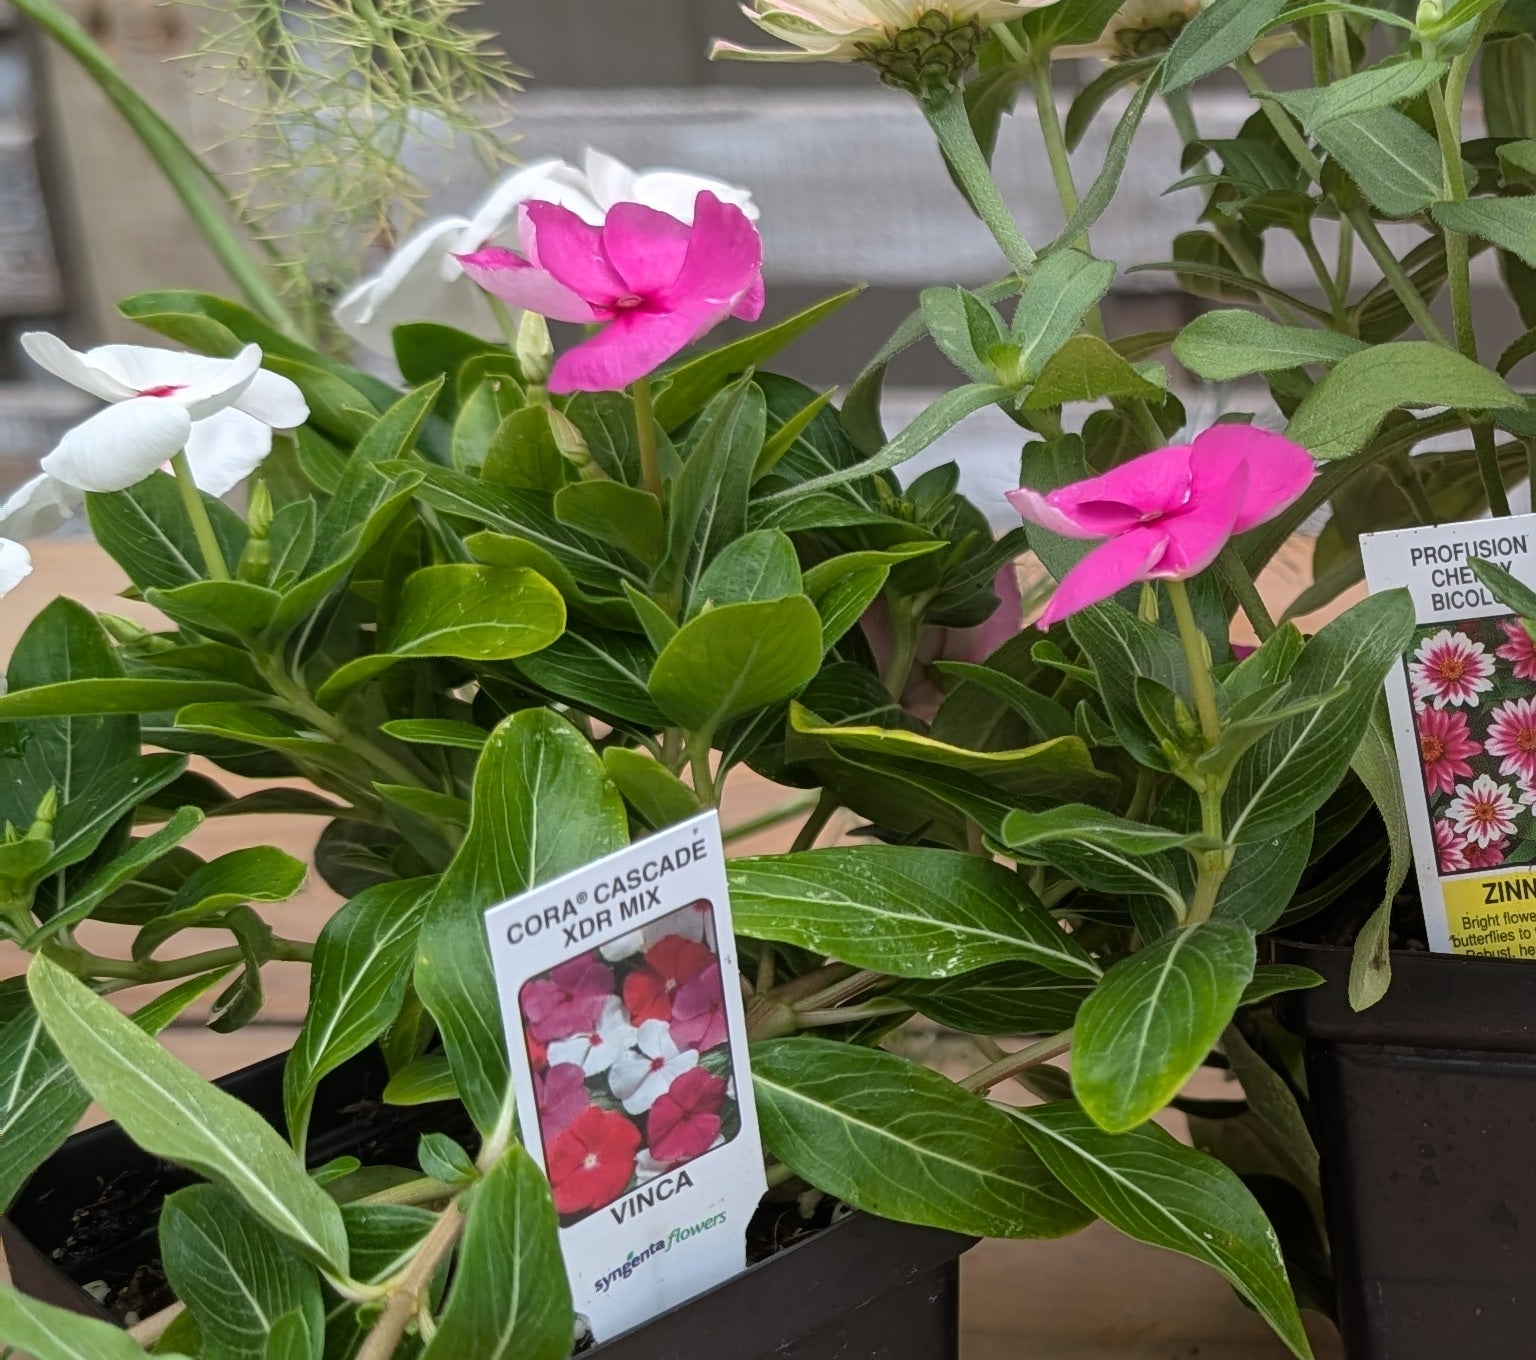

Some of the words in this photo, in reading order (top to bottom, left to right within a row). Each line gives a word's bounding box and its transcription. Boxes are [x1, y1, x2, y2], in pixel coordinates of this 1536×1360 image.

[1410, 534, 1528, 566] PROFUSION
[1431, 560, 1512, 588] CHEY
[1431, 588, 1504, 612] BICOL
[594, 838, 708, 905] CASCADE
[562, 909, 613, 948] XDR
[620, 886, 662, 921] MIX
[1461, 913, 1501, 931] Bright
[1452, 929, 1516, 948] butterflies
[1518, 927, 1532, 940] to
[610, 1170, 694, 1225] VINCA
[594, 1239, 666, 1293] syngenta
[663, 1211, 727, 1253] flowers
